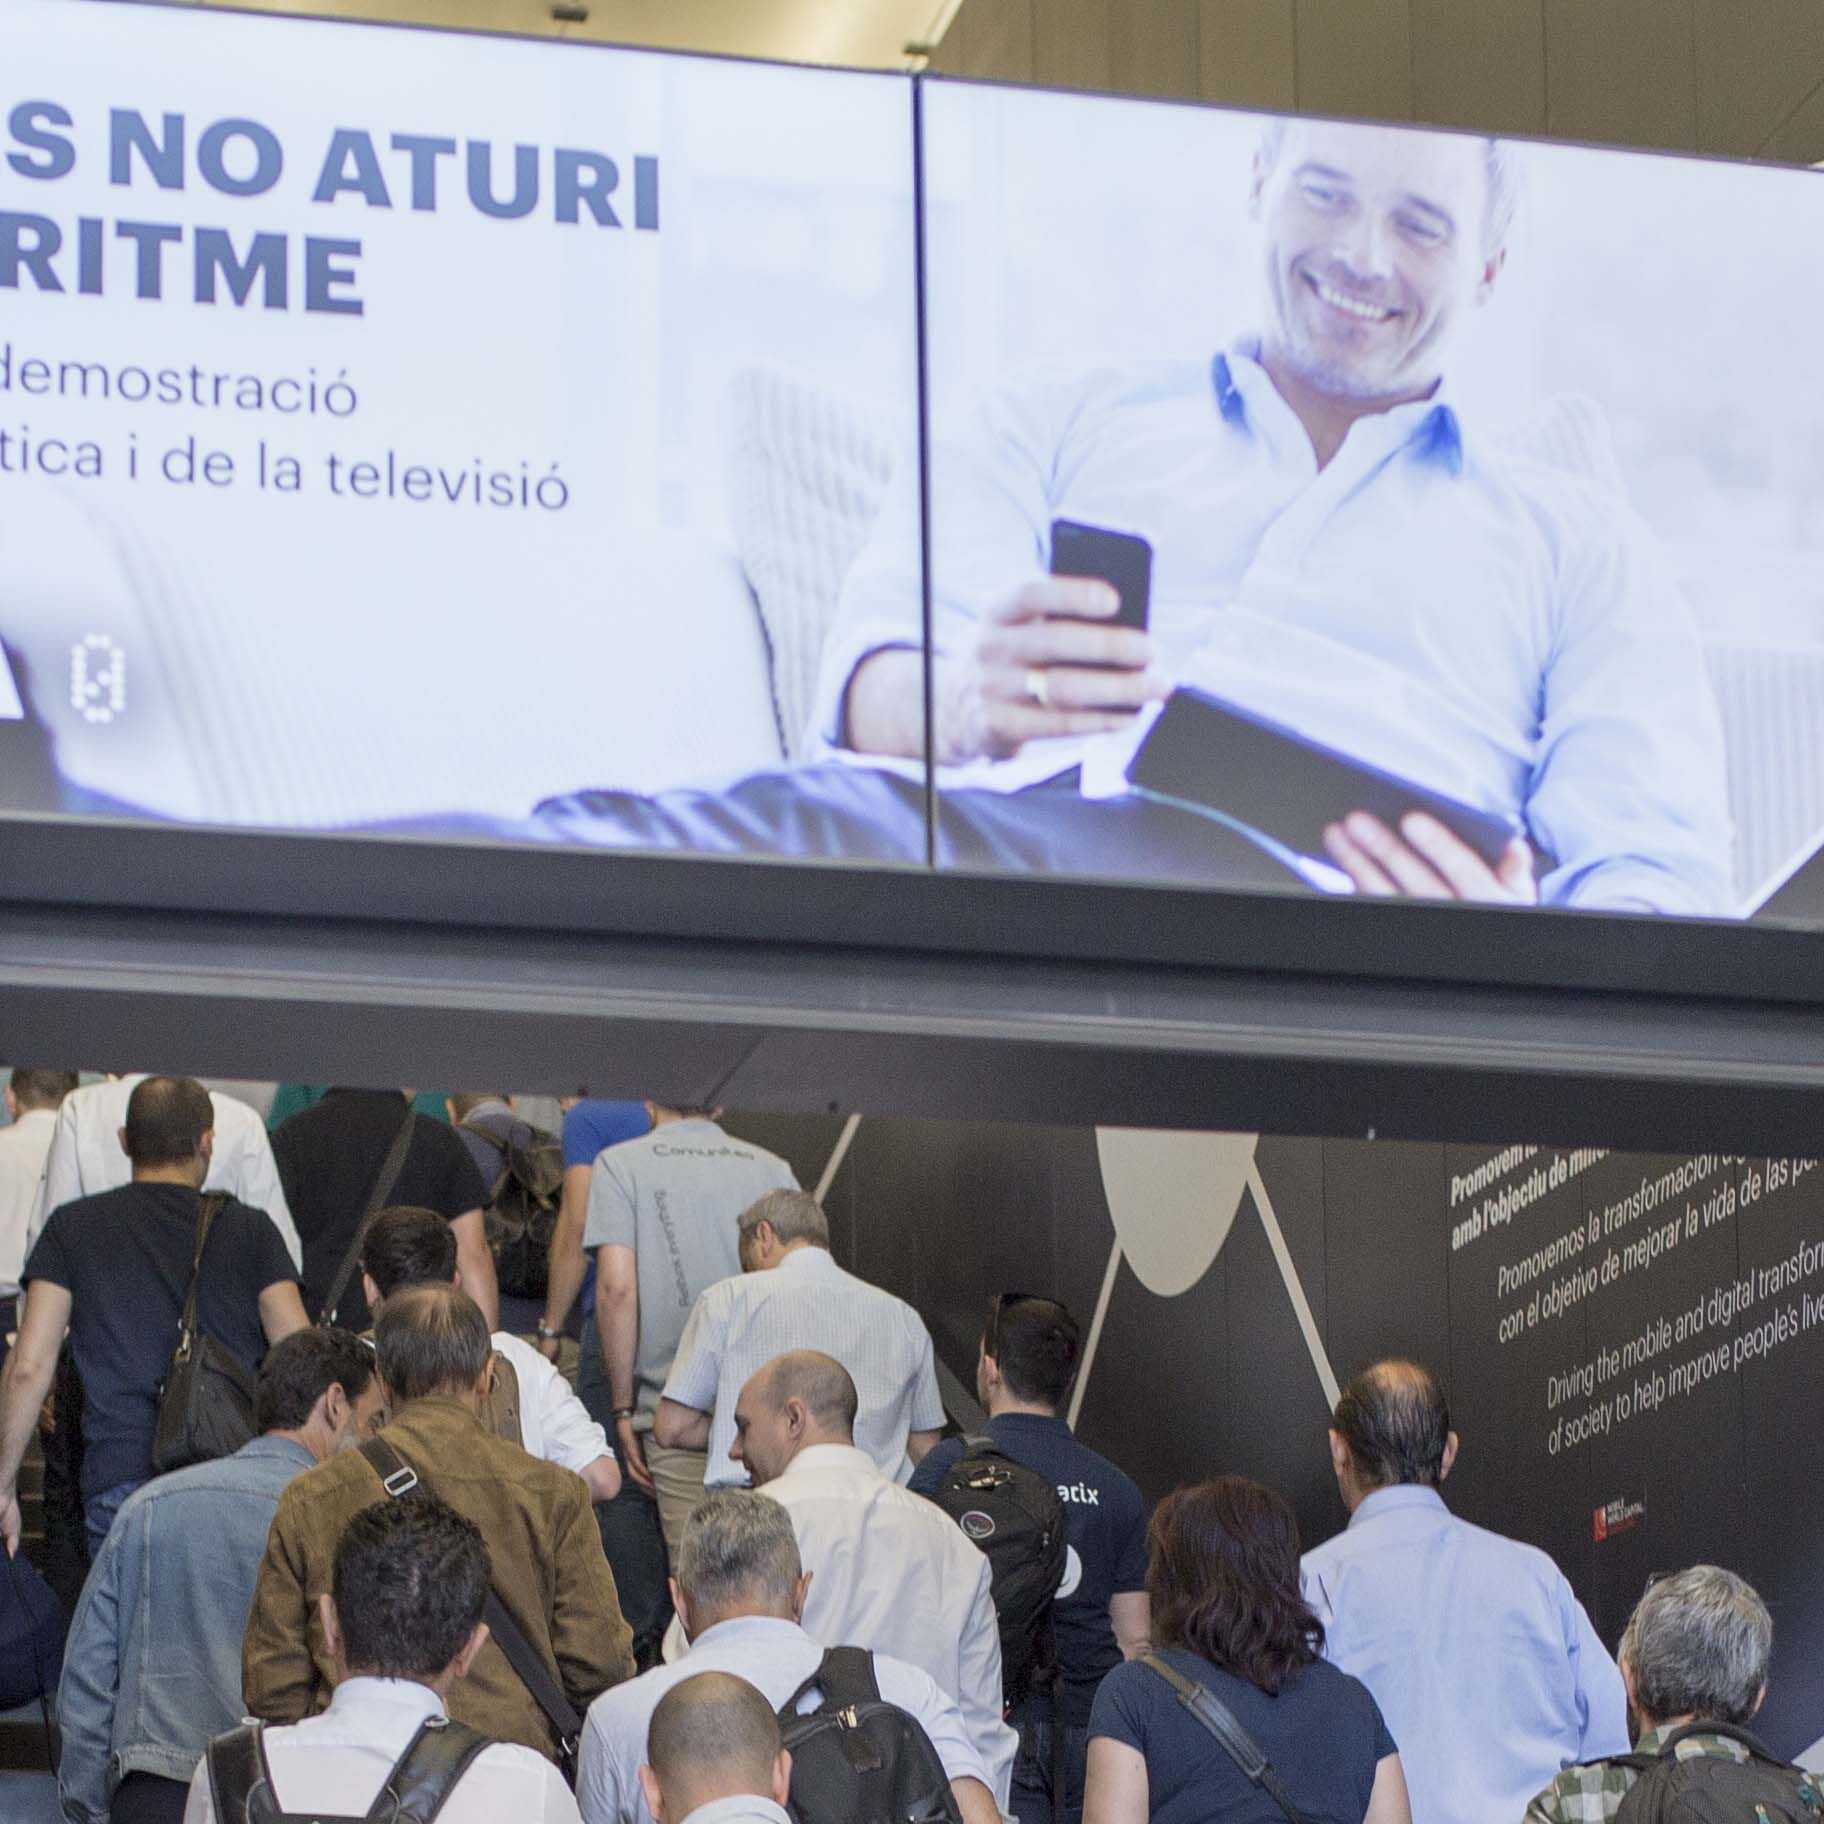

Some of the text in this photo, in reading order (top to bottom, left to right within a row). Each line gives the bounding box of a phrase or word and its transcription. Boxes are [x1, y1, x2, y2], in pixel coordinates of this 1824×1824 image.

[110, 109, 283, 197] NO
[312, 128, 659, 231] ATURI
[128, 432, 138, 479] i
[162, 437, 234, 485] de
[260, 442, 300, 490] la
[328, 452, 568, 509] televisió
[1452, 1208, 1481, 1250] amb
[1549, 1154, 1567, 1190] de
[1498, 1226, 1585, 1298] Promovemos
[1588, 1211, 1600, 1245] la
[1499, 1309, 1523, 1343] con
[1527, 1290, 1539, 1328] el
[1542, 1267, 1597, 1318] objetivo
[1601, 1248, 1619, 1285] de
[1623, 1217, 1681, 1273] mejorar
[1685, 1203, 1698, 1239] la
[1703, 1182, 1735, 1228] vida
[1741, 1167, 1760, 1207] de
[1548, 1363, 1593, 1410] Driving
[1597, 1347, 1619, 1383] the
[1623, 1315, 1671, 1370] mobile
[1676, 1295, 1703, 1343] and
[1708, 1268, 1754, 1327] digital
[1548, 1417, 1563, 1455] of
[1565, 1401, 1613, 1448] society
[1616, 1393, 1630, 1422] to
[1634, 1370, 1665, 1414] help
[1668, 1344, 1729, 1397] improve
